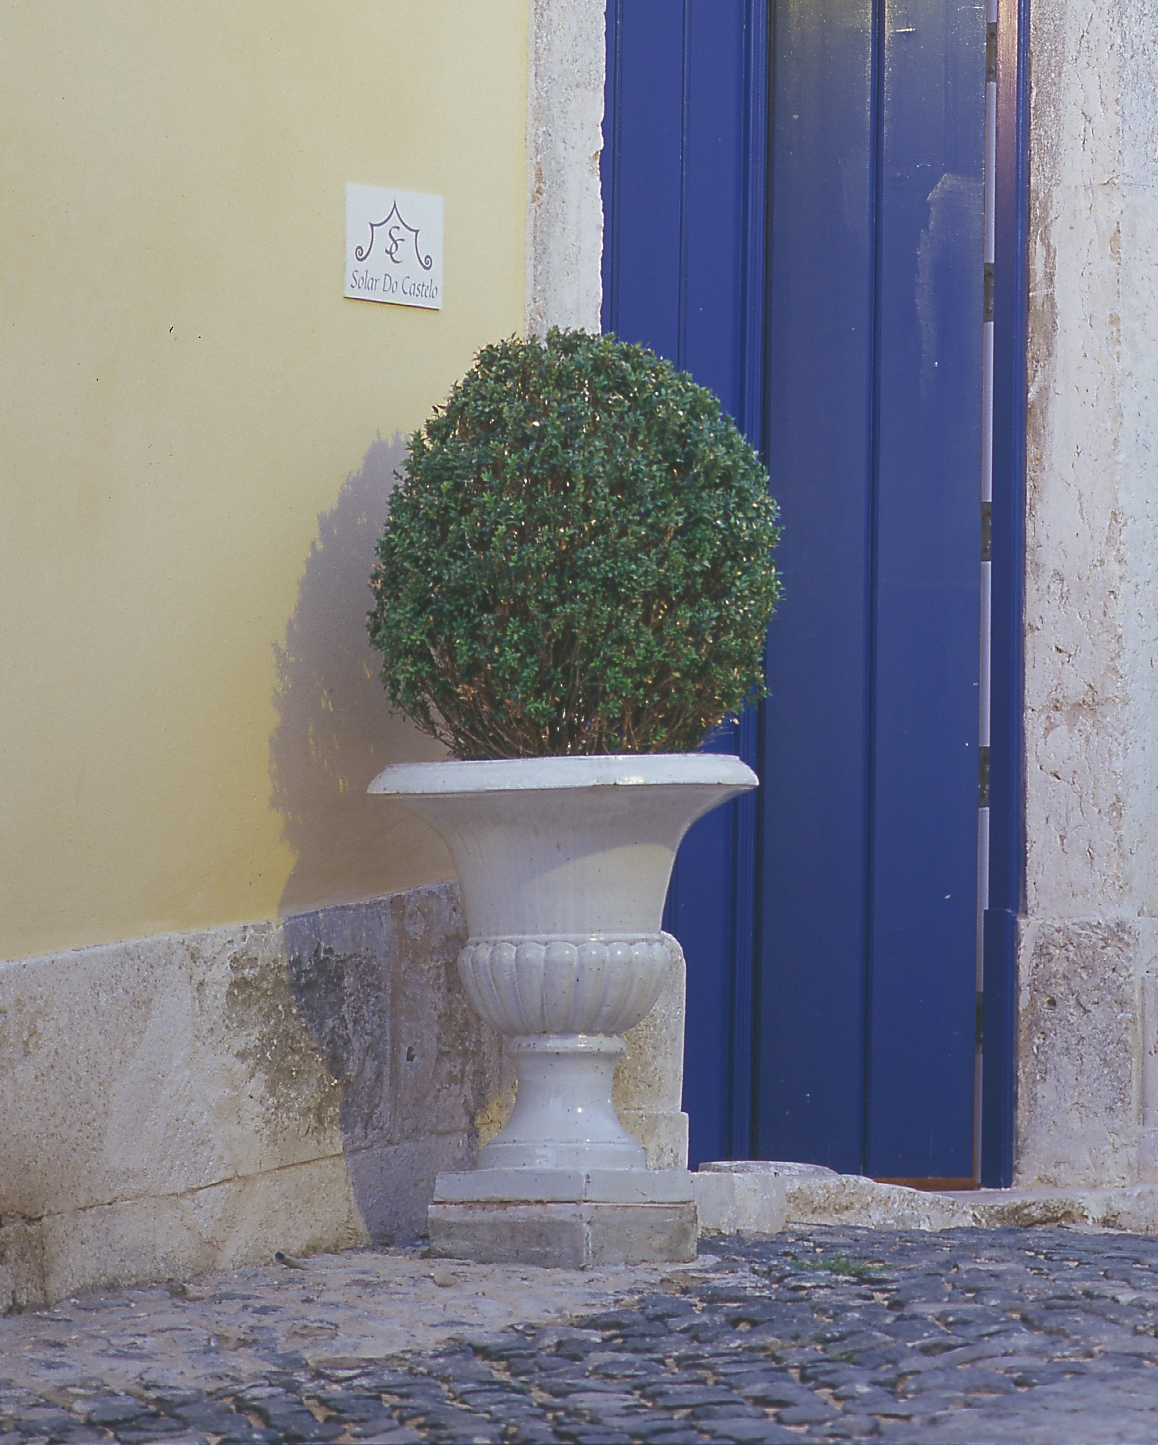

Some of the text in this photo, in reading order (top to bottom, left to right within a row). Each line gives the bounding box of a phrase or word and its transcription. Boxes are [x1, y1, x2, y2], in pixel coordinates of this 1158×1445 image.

[350, 269, 438, 299] Solar Do Castelo
